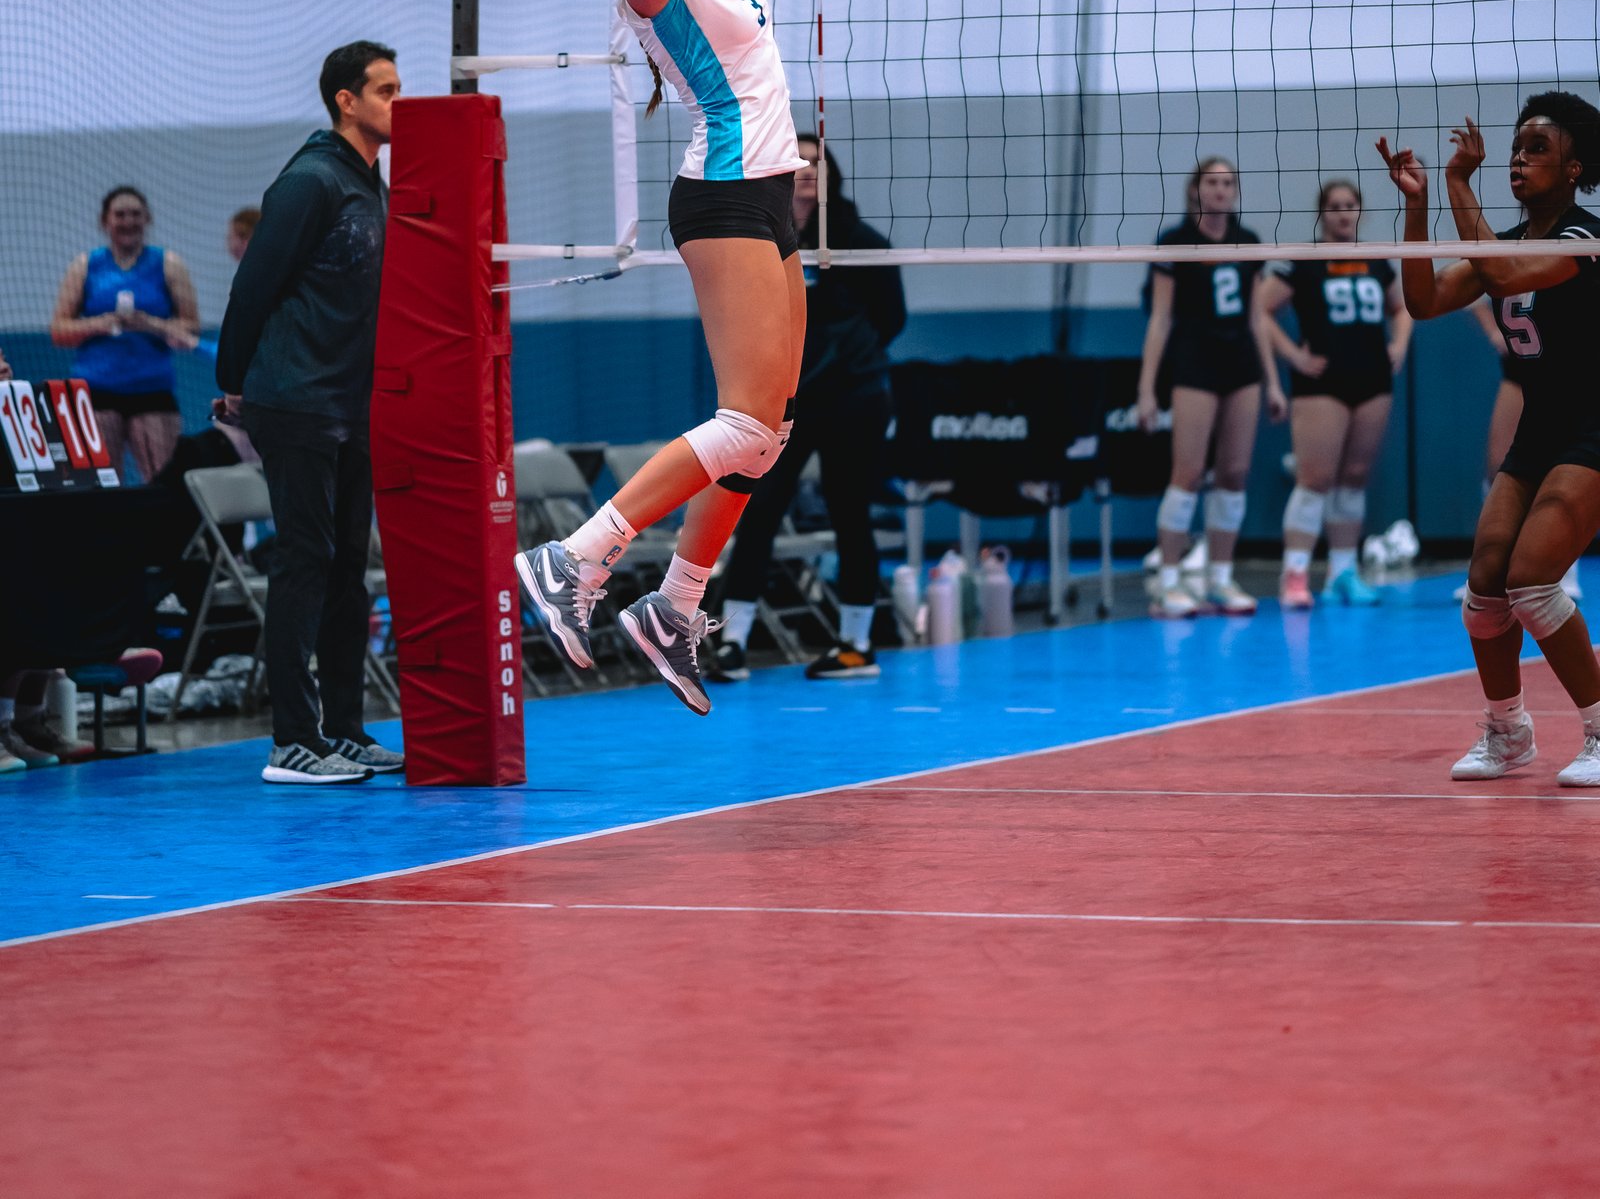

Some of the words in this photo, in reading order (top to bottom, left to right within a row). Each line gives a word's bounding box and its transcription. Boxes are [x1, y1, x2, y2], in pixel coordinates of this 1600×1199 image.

[1212, 267, 1242, 316] 2
[1324, 276, 1384, 324] 59
[1501, 291, 1544, 359] 5
[498, 589, 515, 716] senoh
